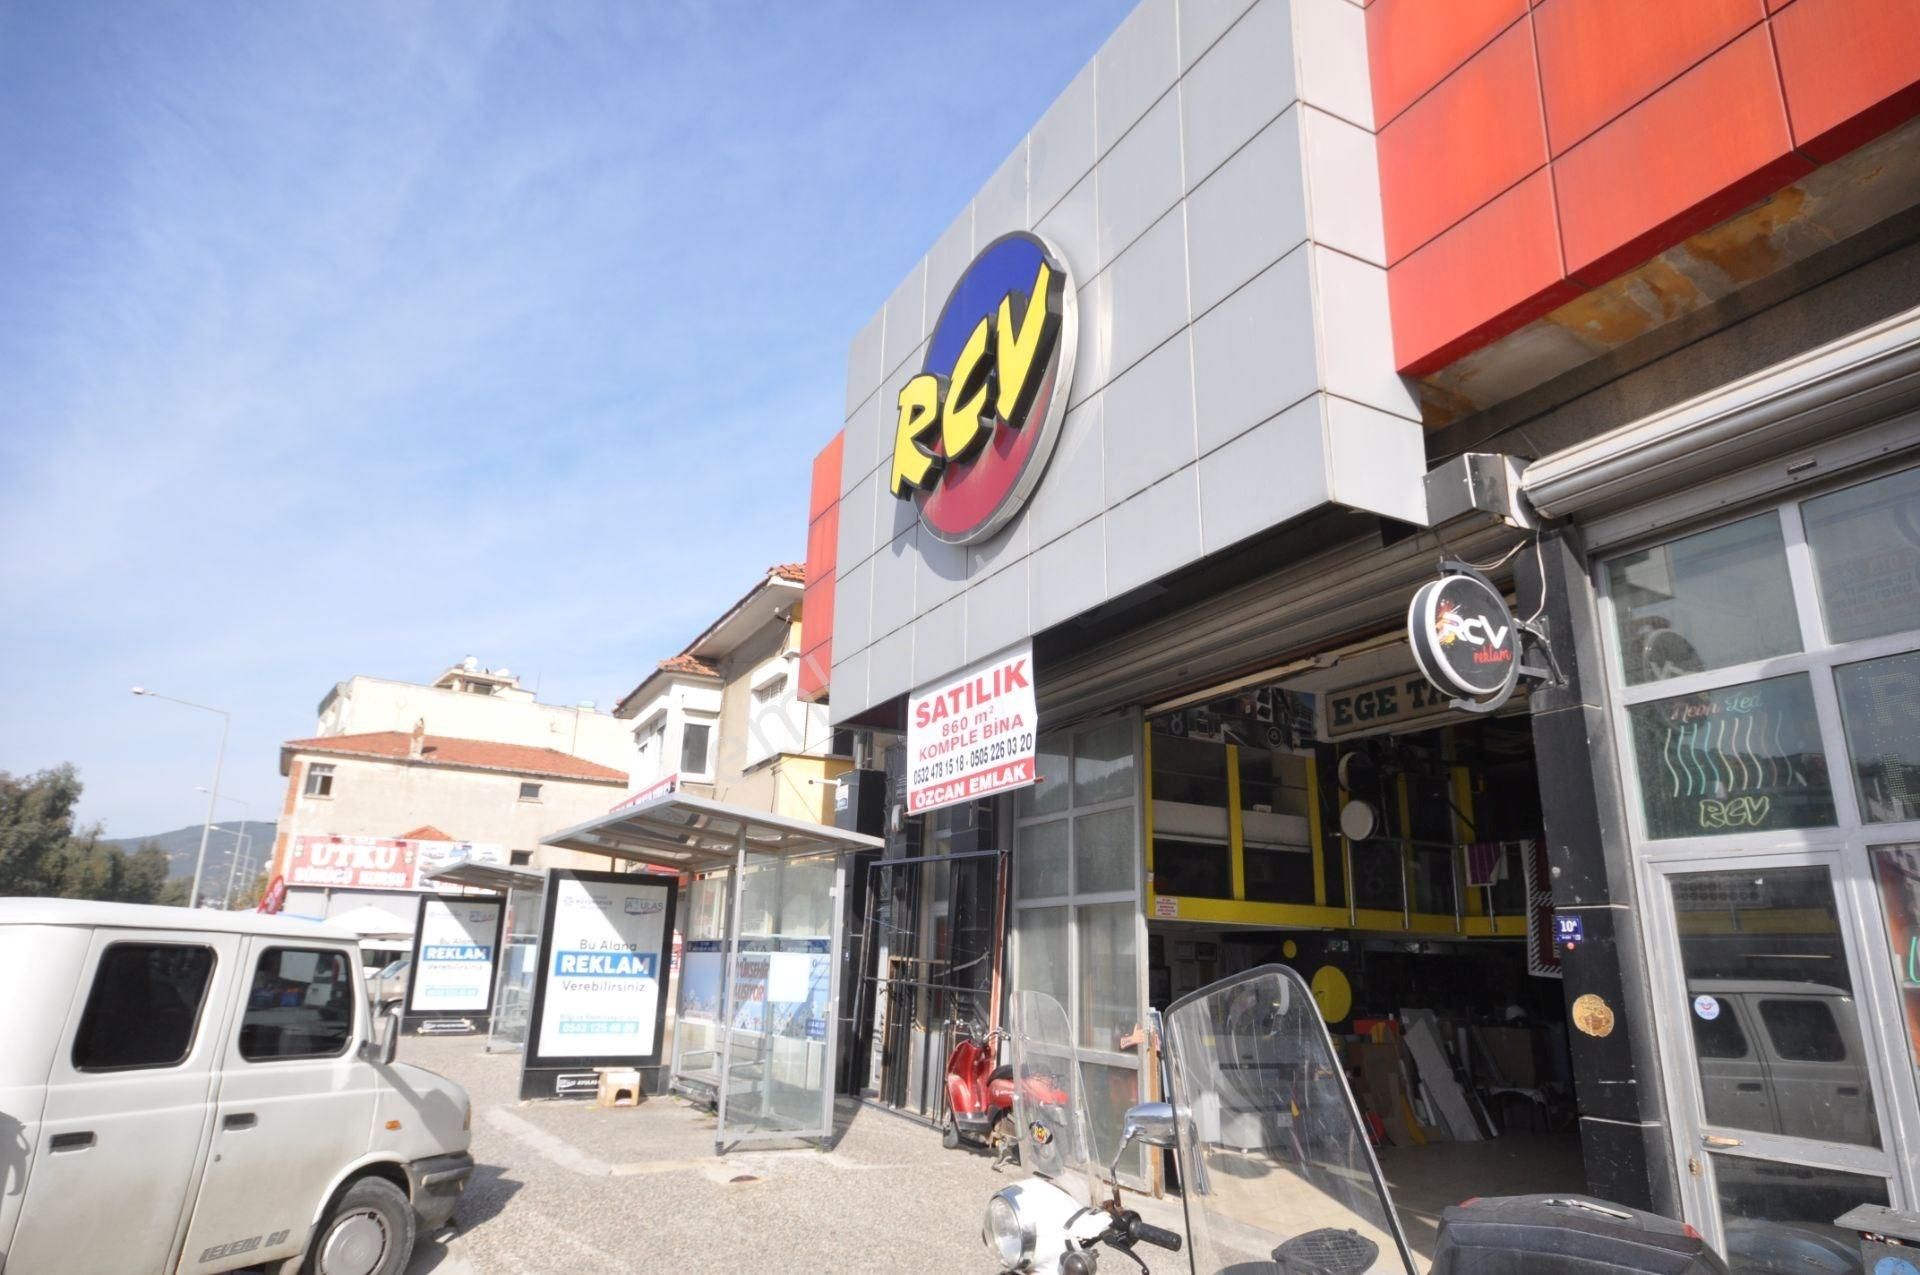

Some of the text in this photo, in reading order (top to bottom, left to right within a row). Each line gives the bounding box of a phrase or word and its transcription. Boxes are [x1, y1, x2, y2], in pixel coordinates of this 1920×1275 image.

[889, 256, 1064, 500] RCV
[1438, 611, 1509, 650] RCV
[1472, 645, 1513, 664] reklam
[915, 658, 1029, 729] SATILIK
[1332, 686, 1398, 727] EGE
[919, 713, 1024, 762] KOMPLE BİNA
[942, 716, 968, 737] 860
[956, 755, 964, 772] 18
[990, 741, 1005, 763] 226
[1007, 736, 1017, 756] 03
[1020, 732, 1033, 752] 20
[915, 762, 1026, 808] ÖZCAN EMLAK
[1700, 796, 1770, 828] RCV
[310, 843, 400, 869] UTKU
[425, 946, 487, 960] REKLAM
[580, 938, 638, 952] Bu Alana
[560, 954, 649, 975] REKLAM
[264, 1228, 290, 1247] 60
